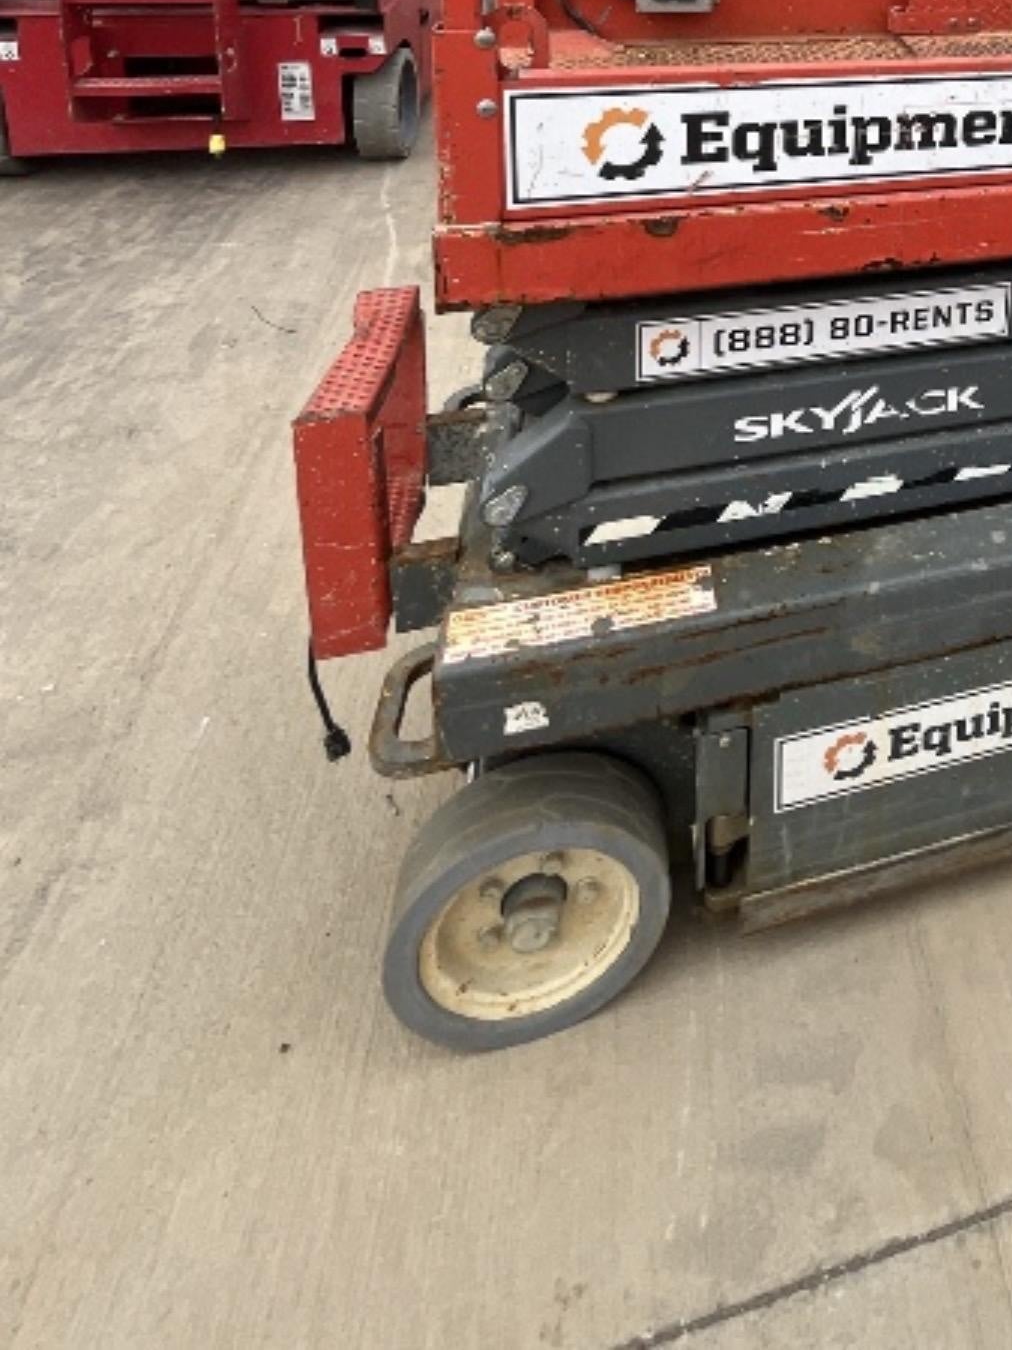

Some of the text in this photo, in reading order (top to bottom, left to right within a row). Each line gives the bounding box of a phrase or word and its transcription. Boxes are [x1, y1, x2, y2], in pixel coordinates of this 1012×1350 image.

[714, 300, 993, 357] (888) 80-RENTS
[734, 384, 985, 442] SKYJACK
